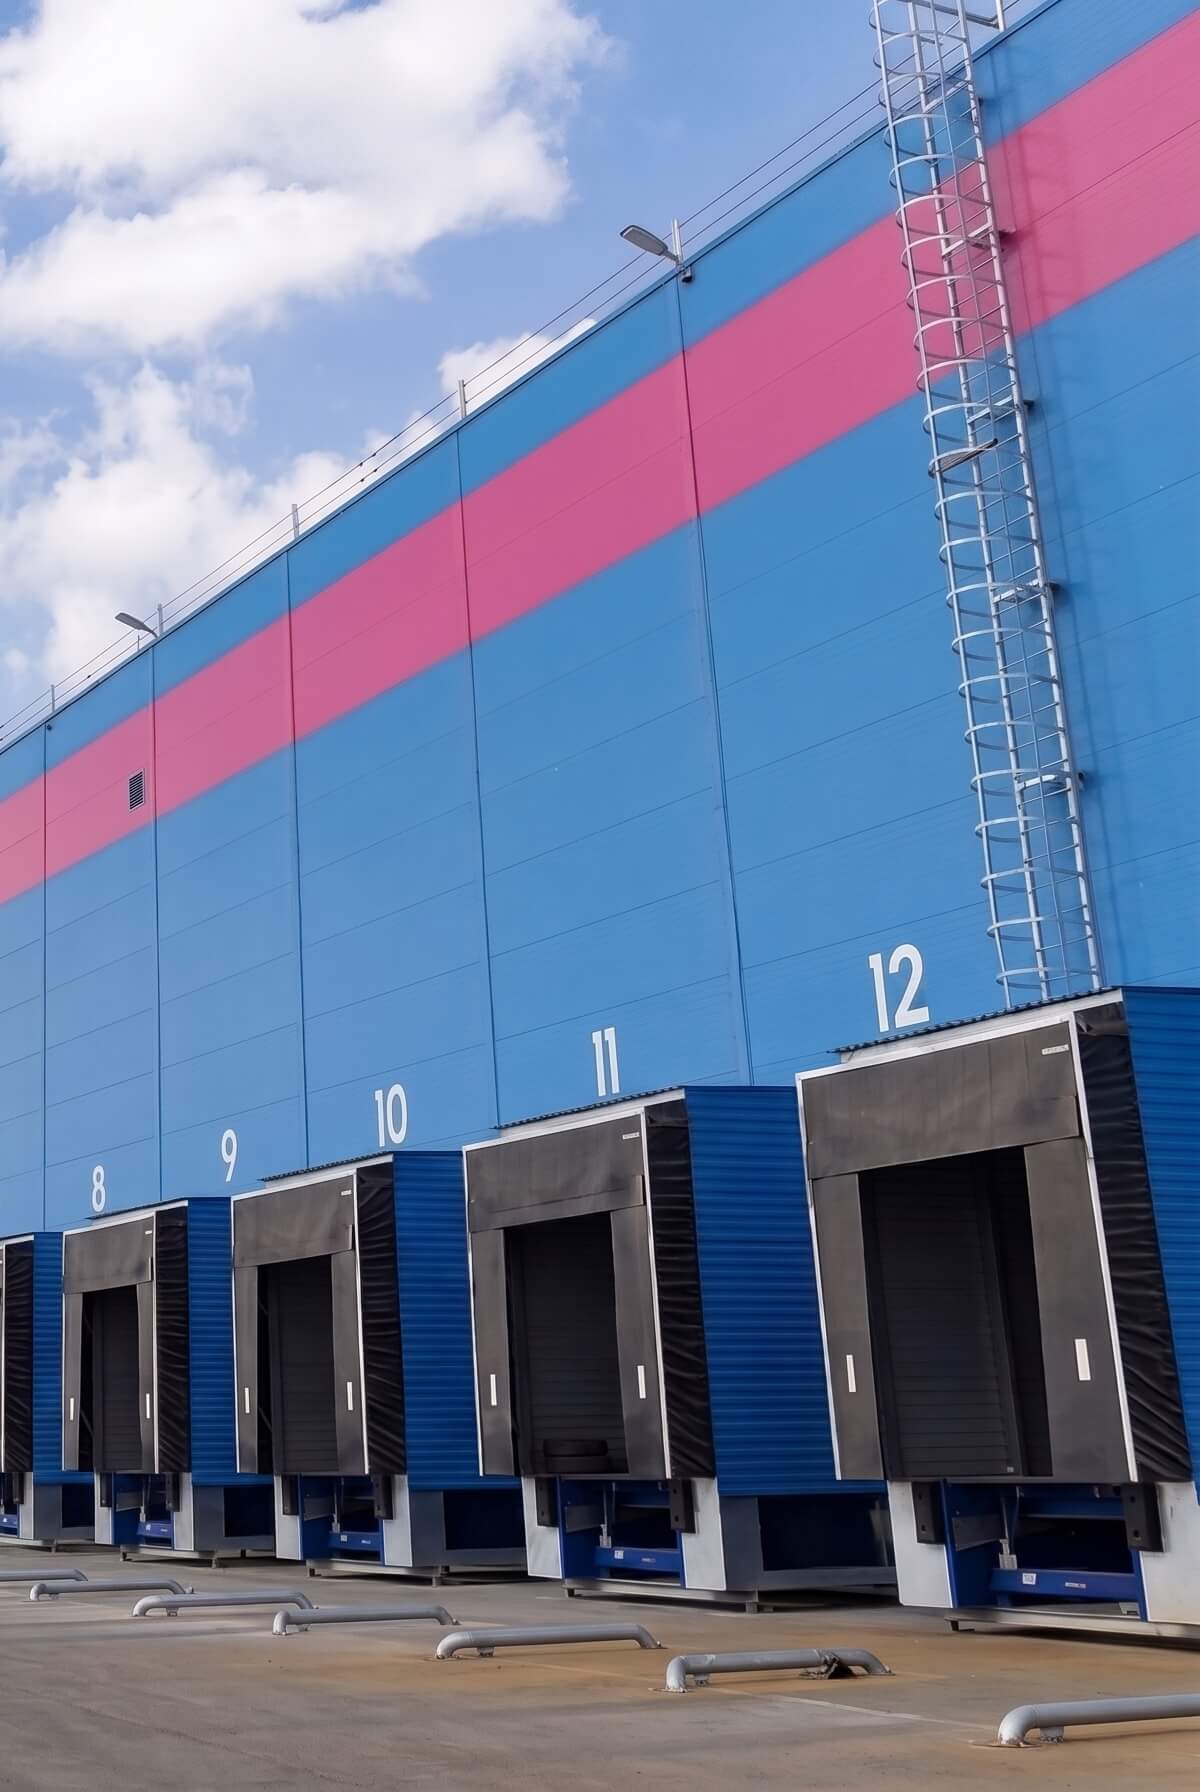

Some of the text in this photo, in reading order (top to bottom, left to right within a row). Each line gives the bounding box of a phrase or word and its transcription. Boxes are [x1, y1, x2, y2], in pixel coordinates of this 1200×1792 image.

[868, 943, 931, 1032] 12
[591, 1027, 621, 1096] 11
[374, 1083, 408, 1147] 10
[221, 1129, 238, 1182] 9
[91, 1165, 106, 1212] 8
